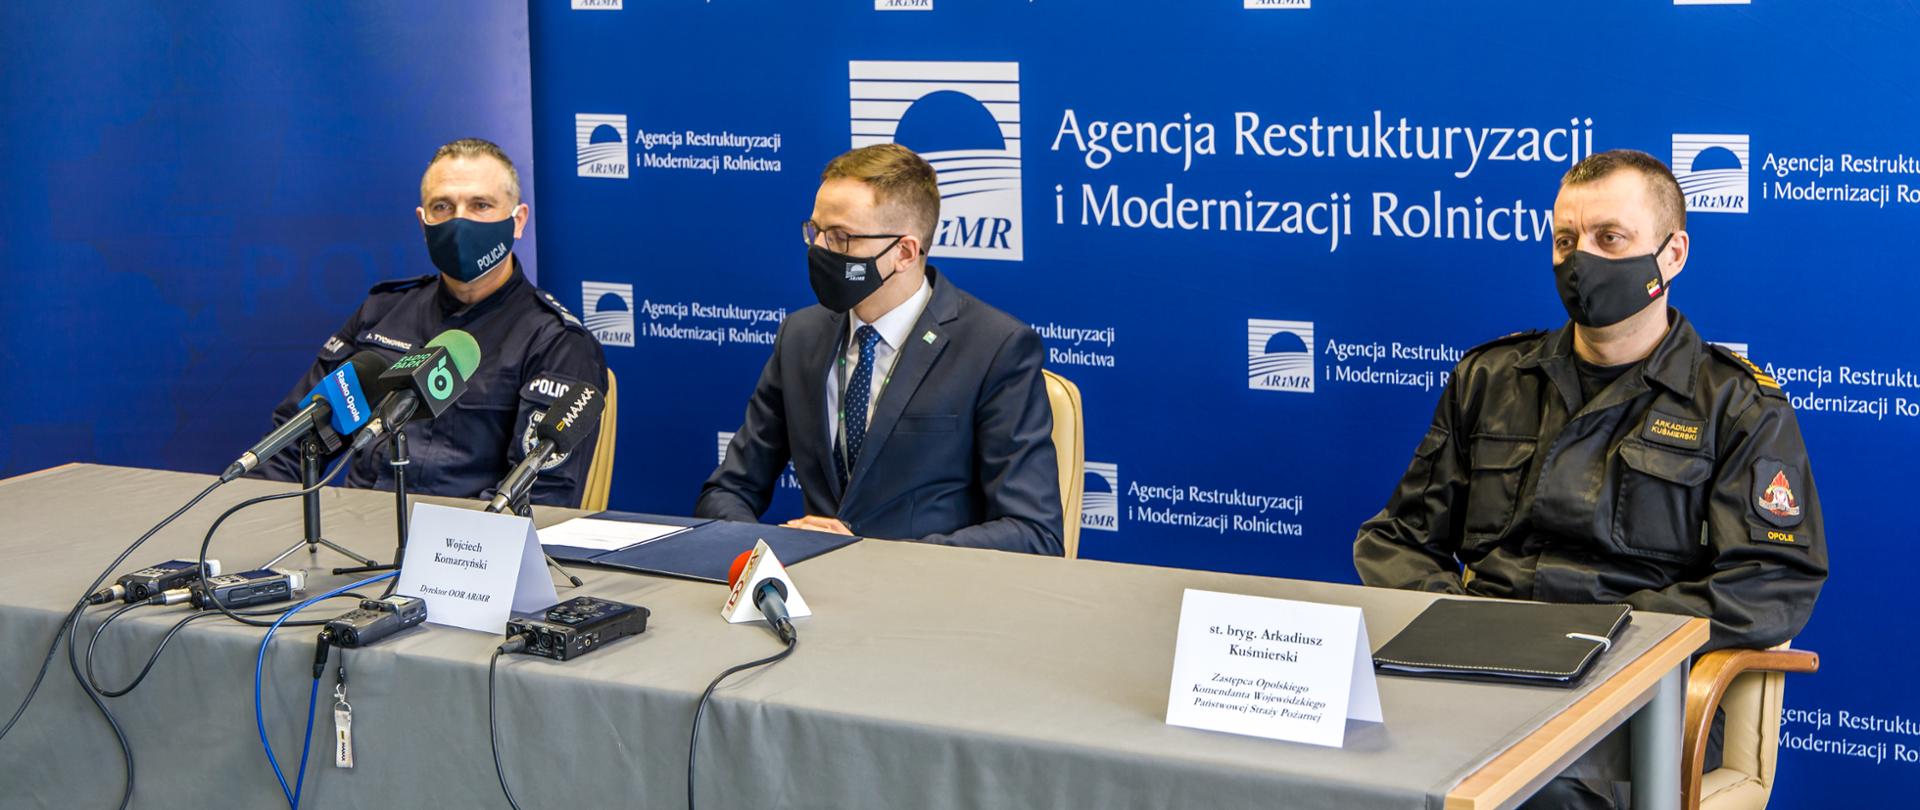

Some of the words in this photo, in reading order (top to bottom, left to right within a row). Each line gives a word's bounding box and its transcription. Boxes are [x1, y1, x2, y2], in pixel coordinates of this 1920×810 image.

[635, 129, 683, 150] Agencja
[686, 131, 781, 153] Restrukturyzacji
[1051, 109, 1216, 172] Agencja
[1234, 110, 1593, 179] Restrukturyzacji
[586, 162, 626, 174] ARiMR
[636, 153, 641, 167] i
[644, 153, 720, 175] Modernizacji
[723, 155, 781, 172] Rolnictwa
[1762, 153, 1834, 178] Agencja
[1687, 194, 1744, 209] ARiMR
[1762, 182, 1767, 199] i
[1774, 181, 1889, 208] Modernizacji
[1898, 184, 1920, 204] Ro
[1055, 184, 1064, 224] i
[1081, 183, 1351, 252] Modernizacji
[1372, 190, 1554, 241] Rolnictw
[937, 216, 1012, 250] iMR
[476, 242, 507, 270] POLICJA
[641, 299, 688, 320] Agencja
[692, 303, 786, 326] Restrukturyzacji
[642, 322, 646, 336] i
[651, 323, 725, 346] Modernizacji
[729, 327, 777, 345] Rolnictw
[1031, 322, 1115, 347] rukturyzacji
[1050, 347, 1115, 367] Rolnictwa
[1325, 339, 1386, 363] Agencja
[1392, 342, 1464, 362] Restruktu
[1260, 374, 1310, 388] ARiMR
[1326, 366, 1330, 381] i
[1335, 365, 1433, 392] Modernizacji
[1764, 362, 1832, 388] Agencja
[1839, 366, 1920, 388] Restruktu
[336, 370, 351, 397] Radio
[347, 394, 361, 423] Opole
[529, 378, 569, 398] POLIC
[1895, 397, 1920, 417] Ro
[1651, 425, 1697, 440] KUŚMIERSKI
[1654, 419, 1698, 433] ARKADIUSZ
[1128, 481, 1184, 505] Agencja
[1189, 486, 1303, 515] Restrukturyzacji
[1081, 512, 1114, 527] RiMR
[1137, 506, 1228, 534] Modernizacji
[1233, 515, 1302, 536] Rolnictwa
[446, 538, 482, 553] Wojciech
[1767, 531, 1794, 542] OPOLE
[434, 552, 488, 570] Komarzyński
[420, 584, 447, 596] Dyrektor
[1209, 625, 1223, 635] st.
[1227, 625, 1257, 641] bryg.
[1261, 629, 1323, 646] Arkadiusz
[1229, 644, 1298, 662] Kuśmierski
[1211, 672, 1253, 687] Zastępca
[1256, 678, 1309, 694] Opolskiego
[1192, 684, 1250, 699] Komendanta
[1254, 691, 1326, 709] Wojewódzkiego
[1194, 697, 1249, 713] Państwowej
[1249, 704, 1279, 717] Straży
[1280, 708, 1322, 723] Pożarnej
[1780, 708, 1831, 731] gencja
[1838, 710, 1920, 735] Restruktu
[1894, 743, 1920, 763] Ro
